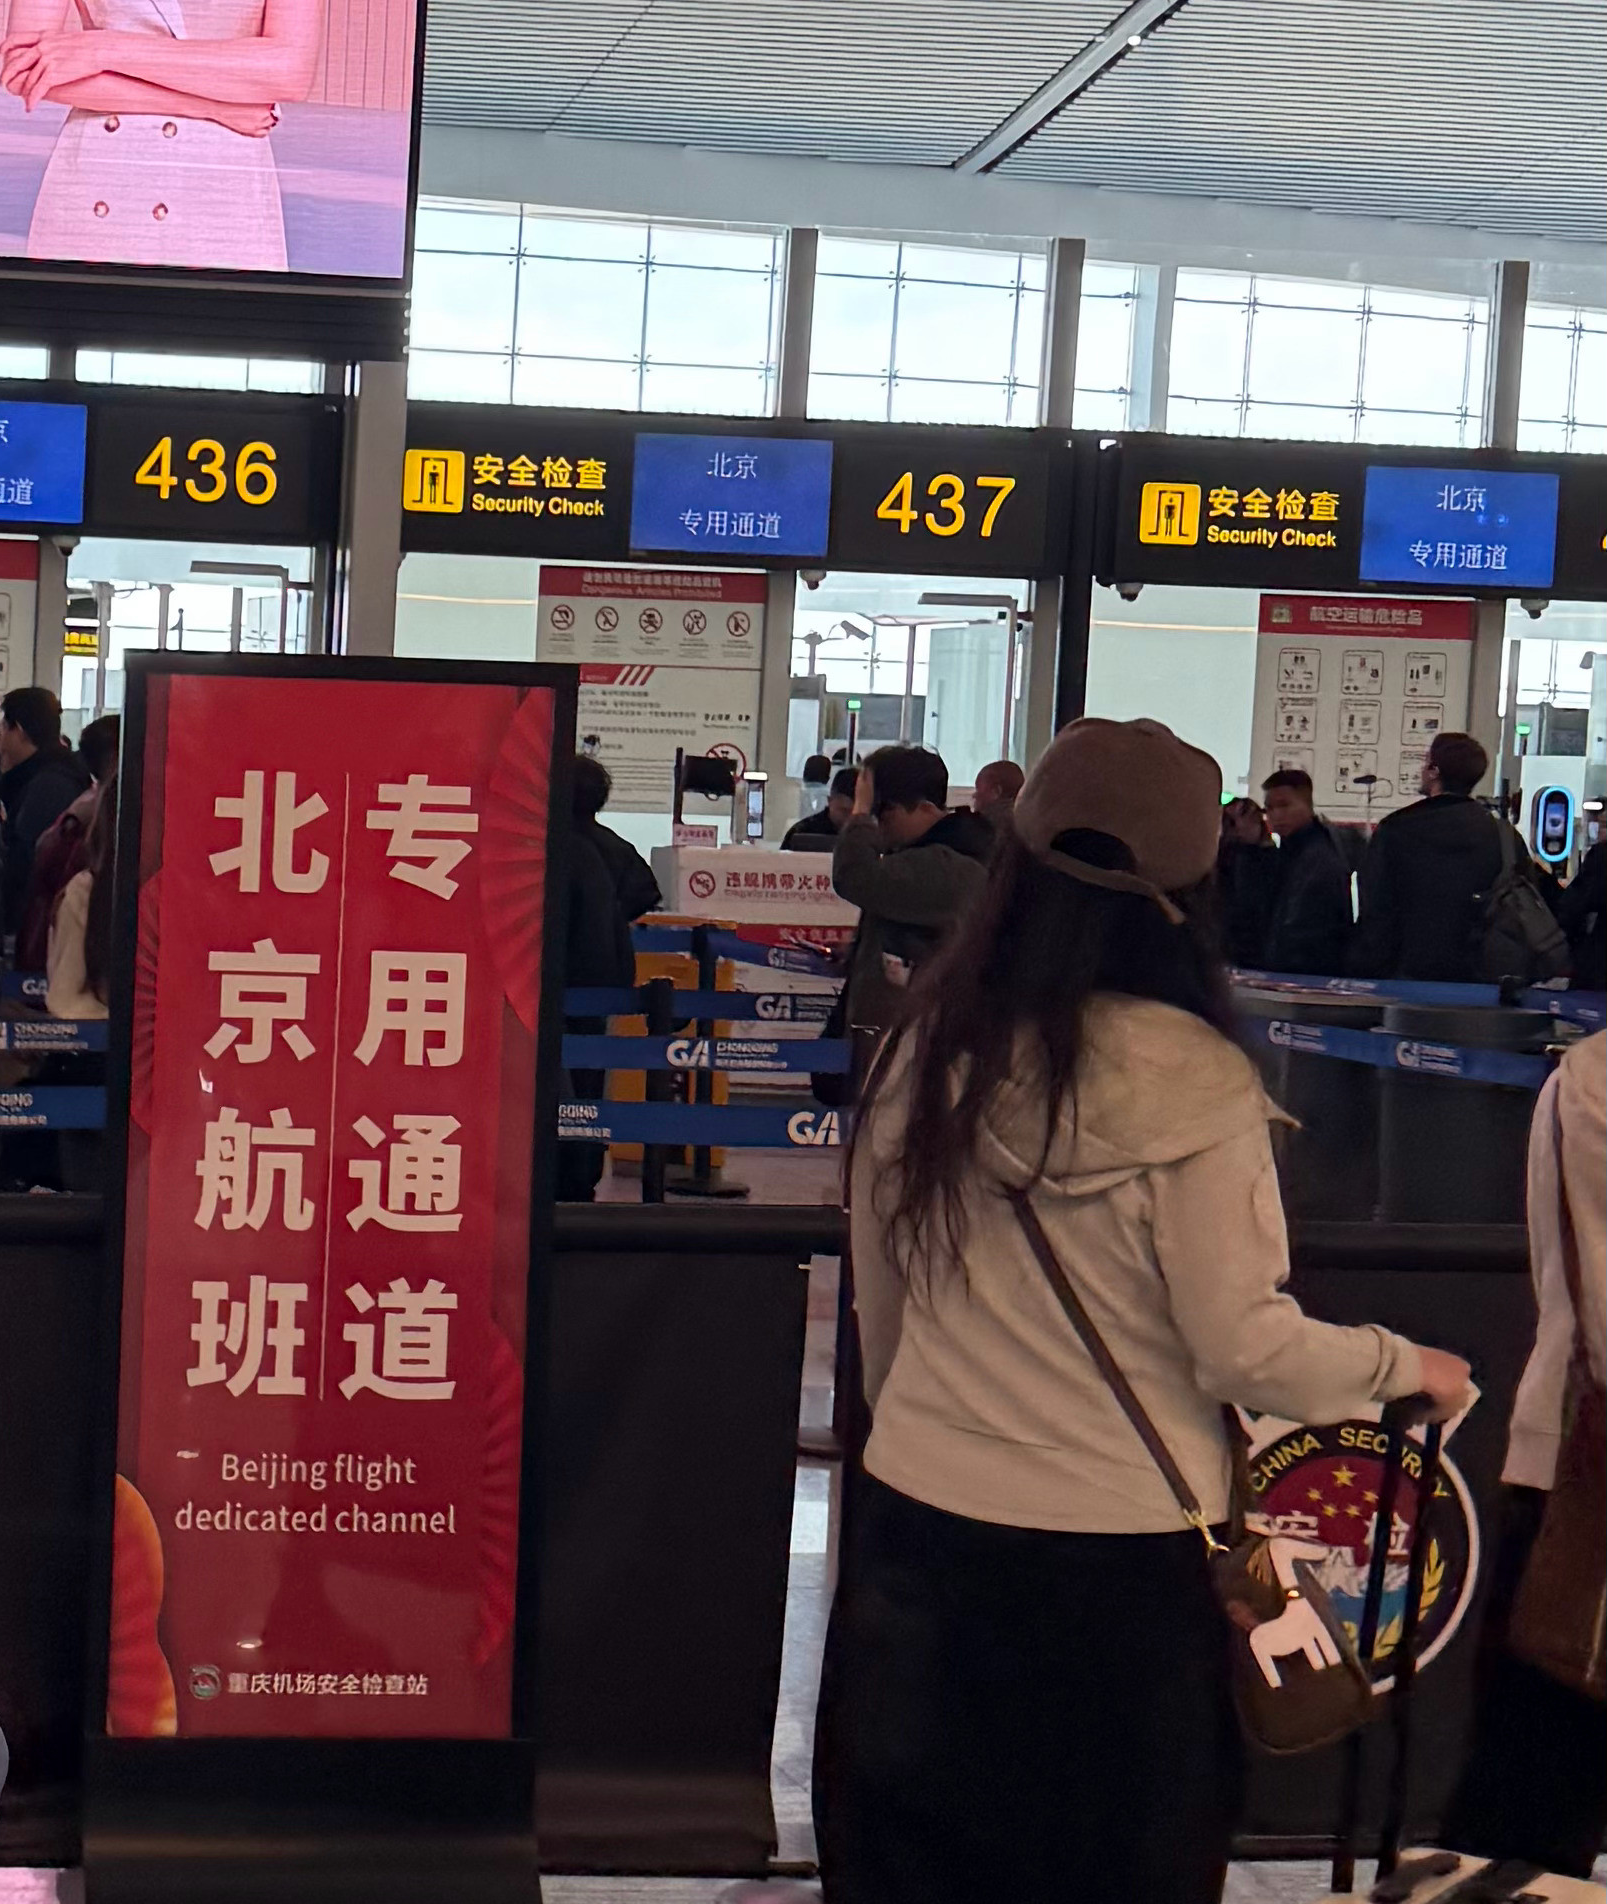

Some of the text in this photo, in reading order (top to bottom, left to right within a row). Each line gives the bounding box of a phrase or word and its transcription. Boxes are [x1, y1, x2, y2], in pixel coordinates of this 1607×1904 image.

[135, 437, 278, 506] 436
[472, 455, 607, 491] 安全检查
[707, 453, 757, 480] 北京
[472, 493, 605, 519] Security Check
[876, 472, 1016, 537] 437
[1208, 486, 1340, 522] 安全检查
[1437, 484, 1485, 510] 北京
[679, 509, 780, 539] 专用通道
[1207, 523, 1337, 549] Security Check
[1409, 541, 1507, 571] 专用通道
[186, 770, 330, 1398] 北京航班
[339, 773, 479, 1401] 专用通道
[221, 1452, 417, 1492] Beijing flight
[1251, 1433, 1323, 1493] CHINA
[175, 1502, 456, 1535] dedicated channel
[228, 1672, 429, 1697] 重庆机场安全检查站
